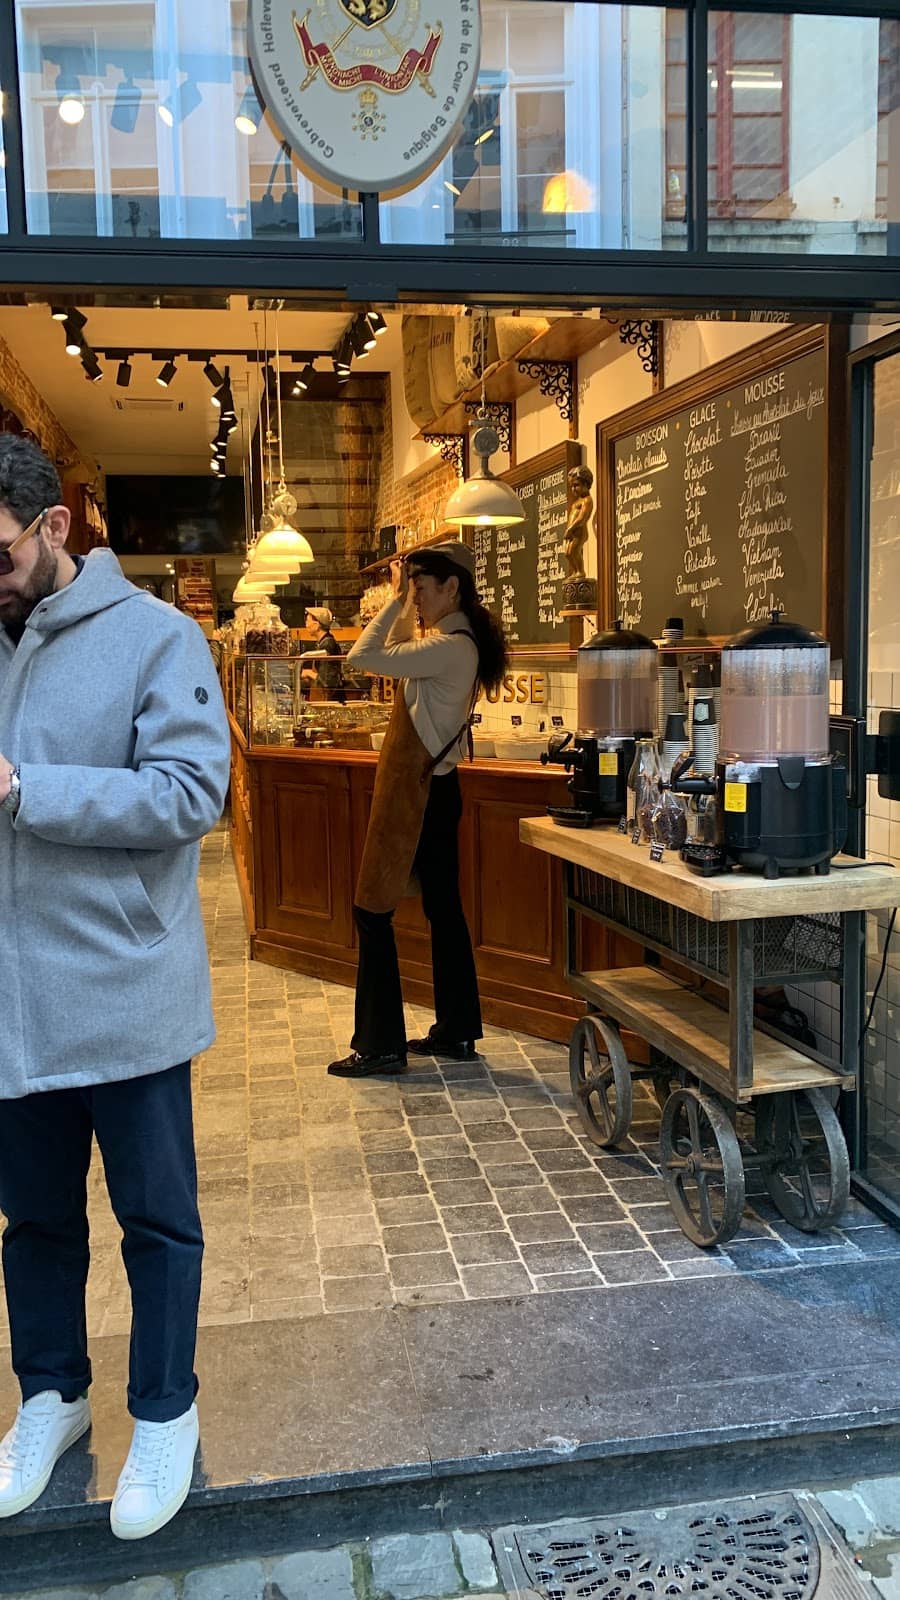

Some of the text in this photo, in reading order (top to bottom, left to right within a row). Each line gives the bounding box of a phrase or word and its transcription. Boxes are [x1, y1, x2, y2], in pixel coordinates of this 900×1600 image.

[461, 19, 473, 37] de
[459, 43, 473, 55] la
[452, 61, 469, 93] Cour
[442, 96, 455, 112] de
[402, 115, 447, 161] Belgique
[635, 372, 785, 451] BOISSON GLACE MOUSSE
[683, 420, 724, 457] Chocolat
